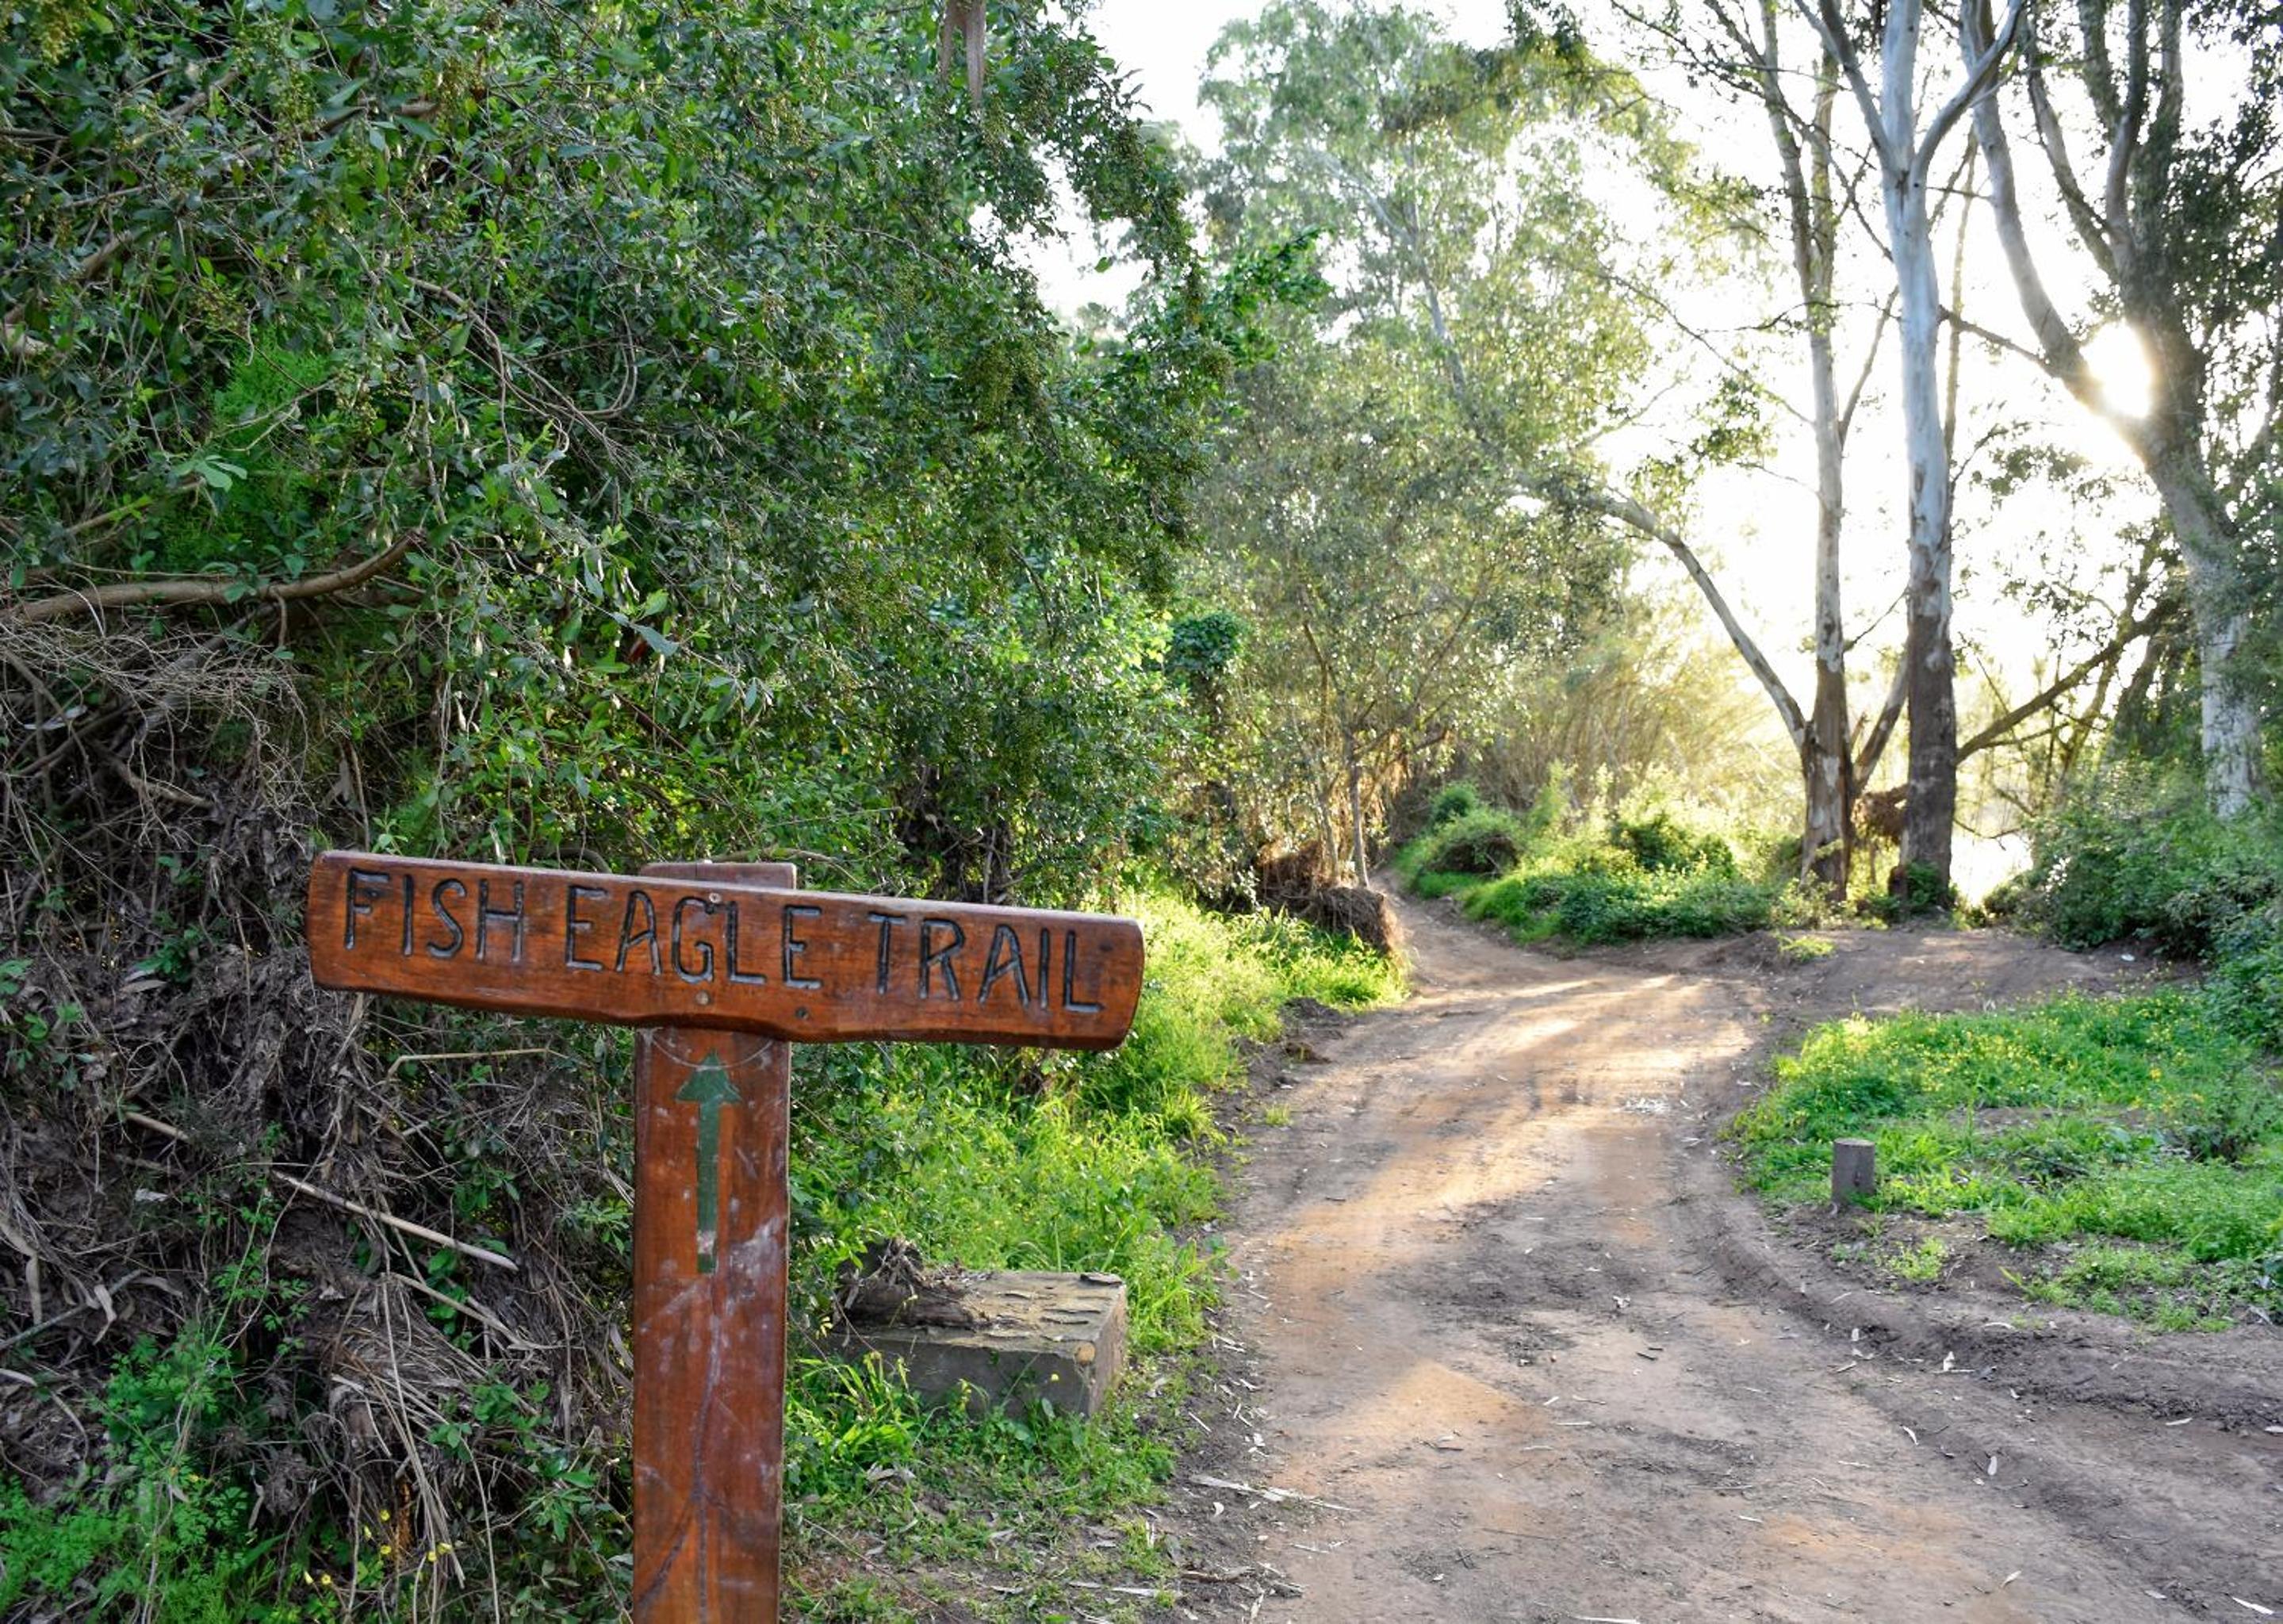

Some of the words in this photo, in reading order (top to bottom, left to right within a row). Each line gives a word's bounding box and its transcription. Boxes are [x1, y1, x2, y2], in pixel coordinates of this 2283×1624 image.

[344, 868, 525, 963] FISH
[565, 884, 822, 989] EAGLE
[868, 912, 1105, 1012] TRAIL
